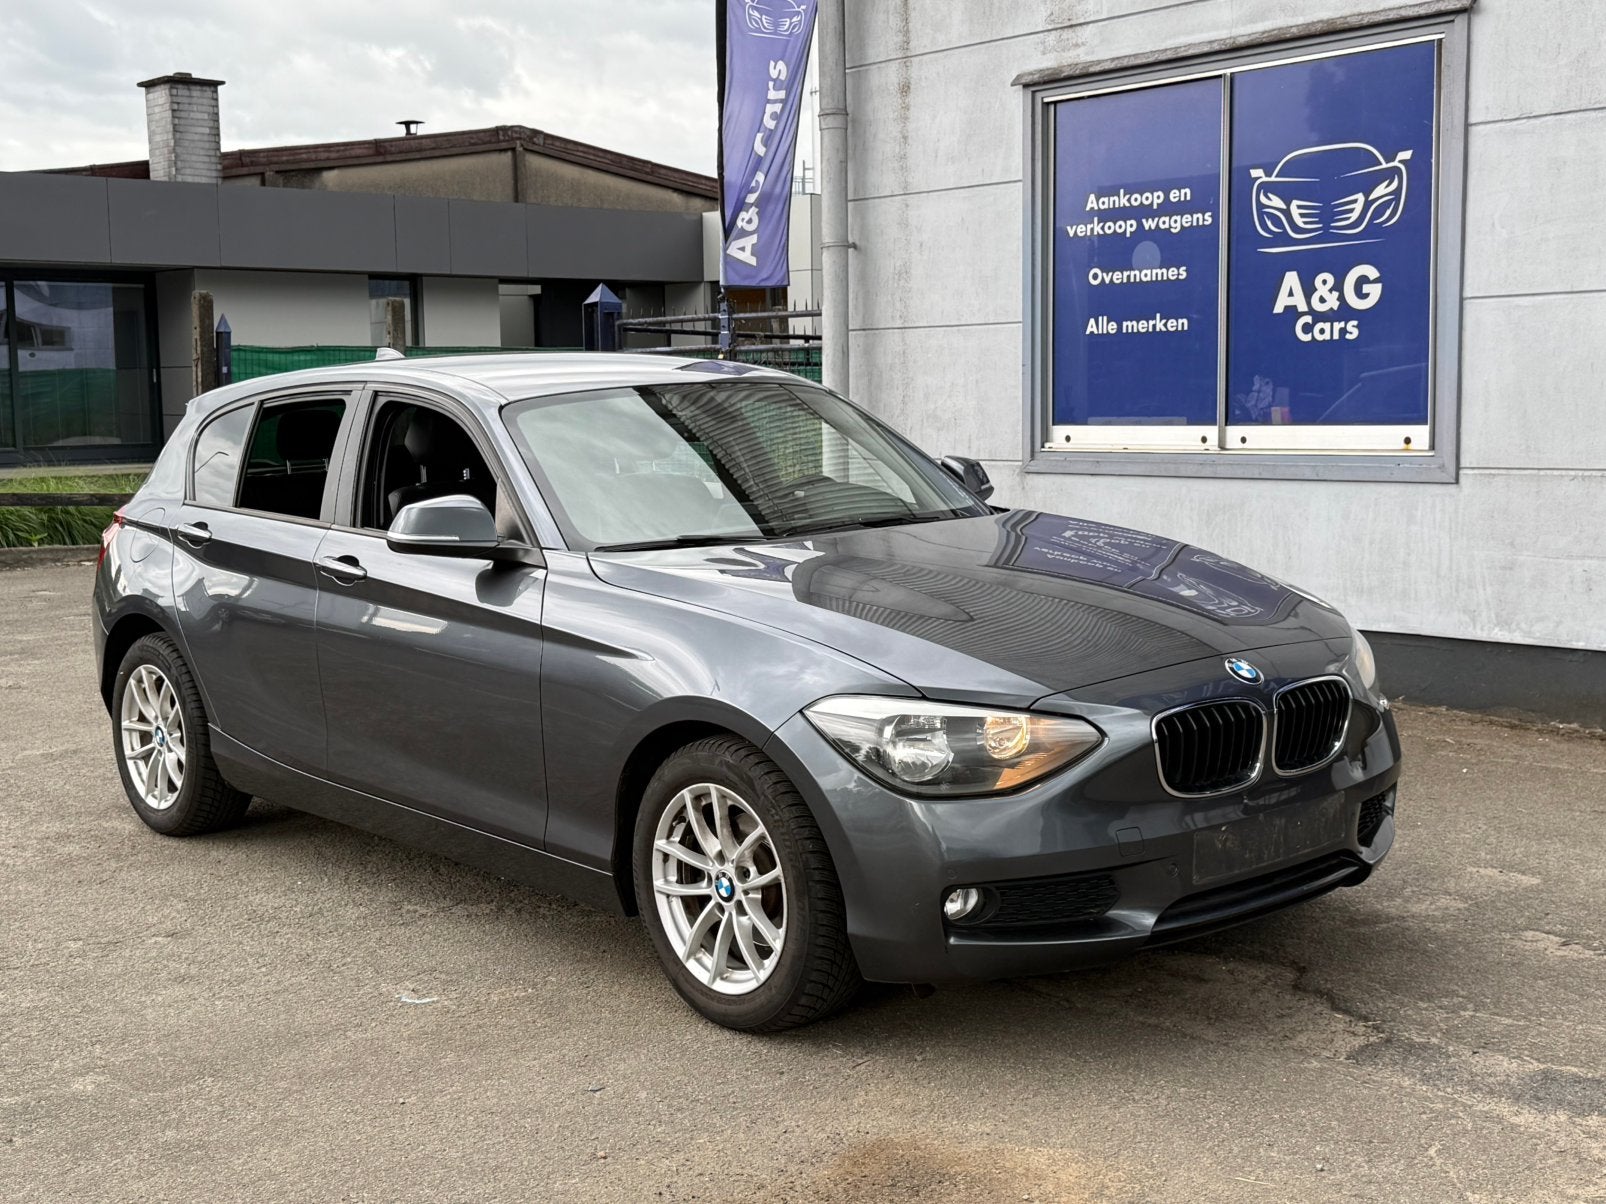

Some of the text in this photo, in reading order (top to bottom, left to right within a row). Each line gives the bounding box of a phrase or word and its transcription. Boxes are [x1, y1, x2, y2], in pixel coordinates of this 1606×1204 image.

[1085, 187, 1191, 212] Aankoop en
[1066, 206, 1213, 238] verkoop wagens
[1088, 265, 1187, 286] Overnames
[1273, 264, 1383, 314] A&G
[1085, 313, 1188, 335] Alle merken
[1295, 314, 1359, 342] Cars
